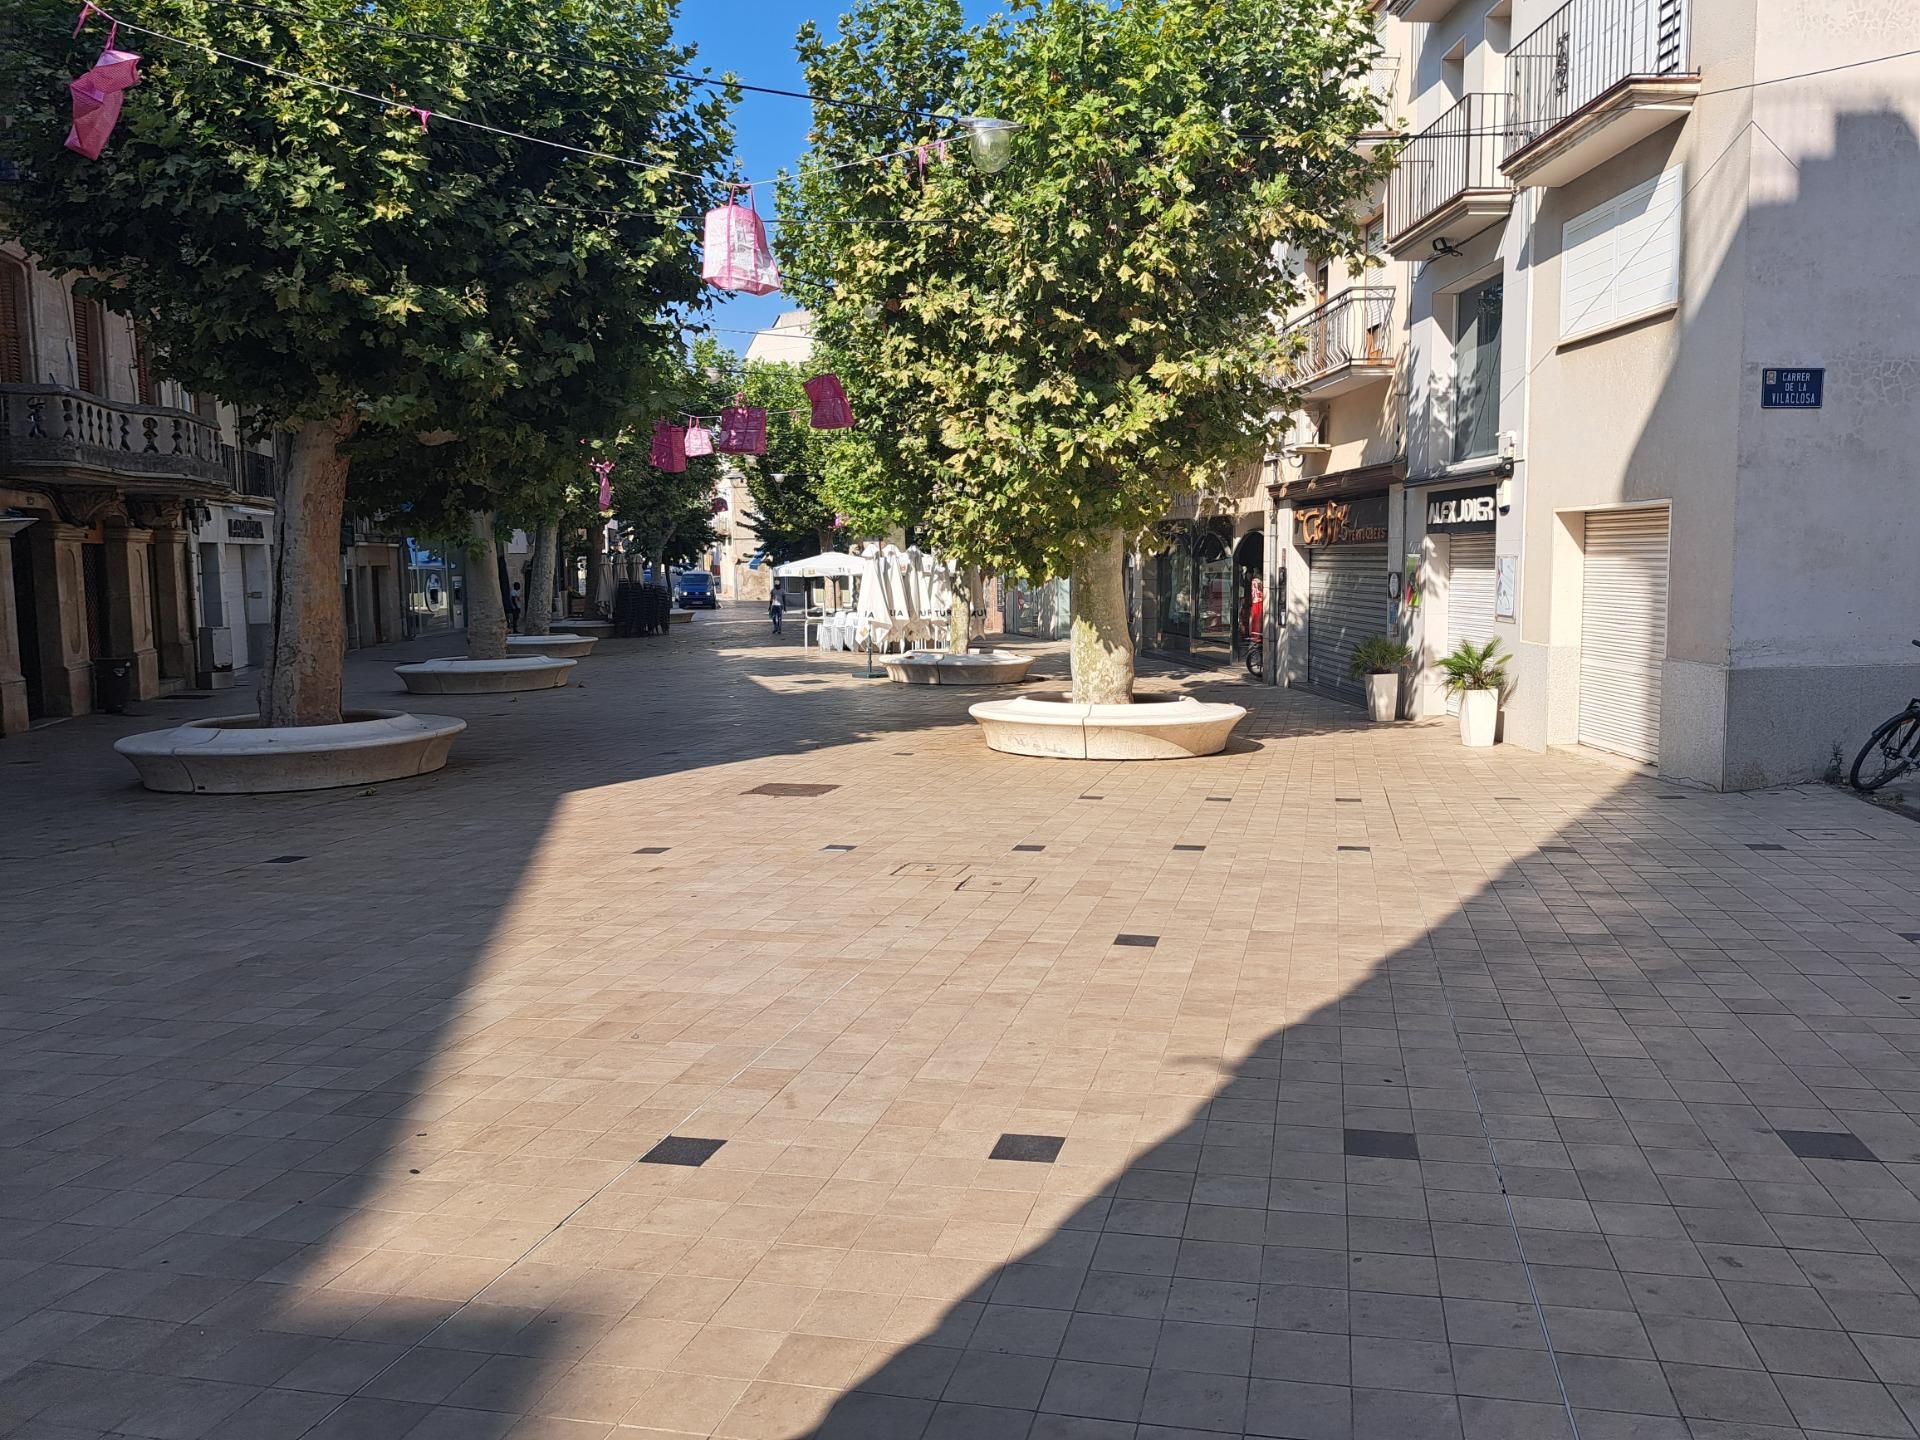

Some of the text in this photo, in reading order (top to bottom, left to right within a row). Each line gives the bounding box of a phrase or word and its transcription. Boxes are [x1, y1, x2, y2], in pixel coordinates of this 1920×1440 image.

[1782, 372, 1811, 382] CARRER
[1784, 382, 1807, 391] DE LA
[1771, 393, 1815, 404] VILACLOSA
[1427, 496, 1494, 525] ALEX JOIER
